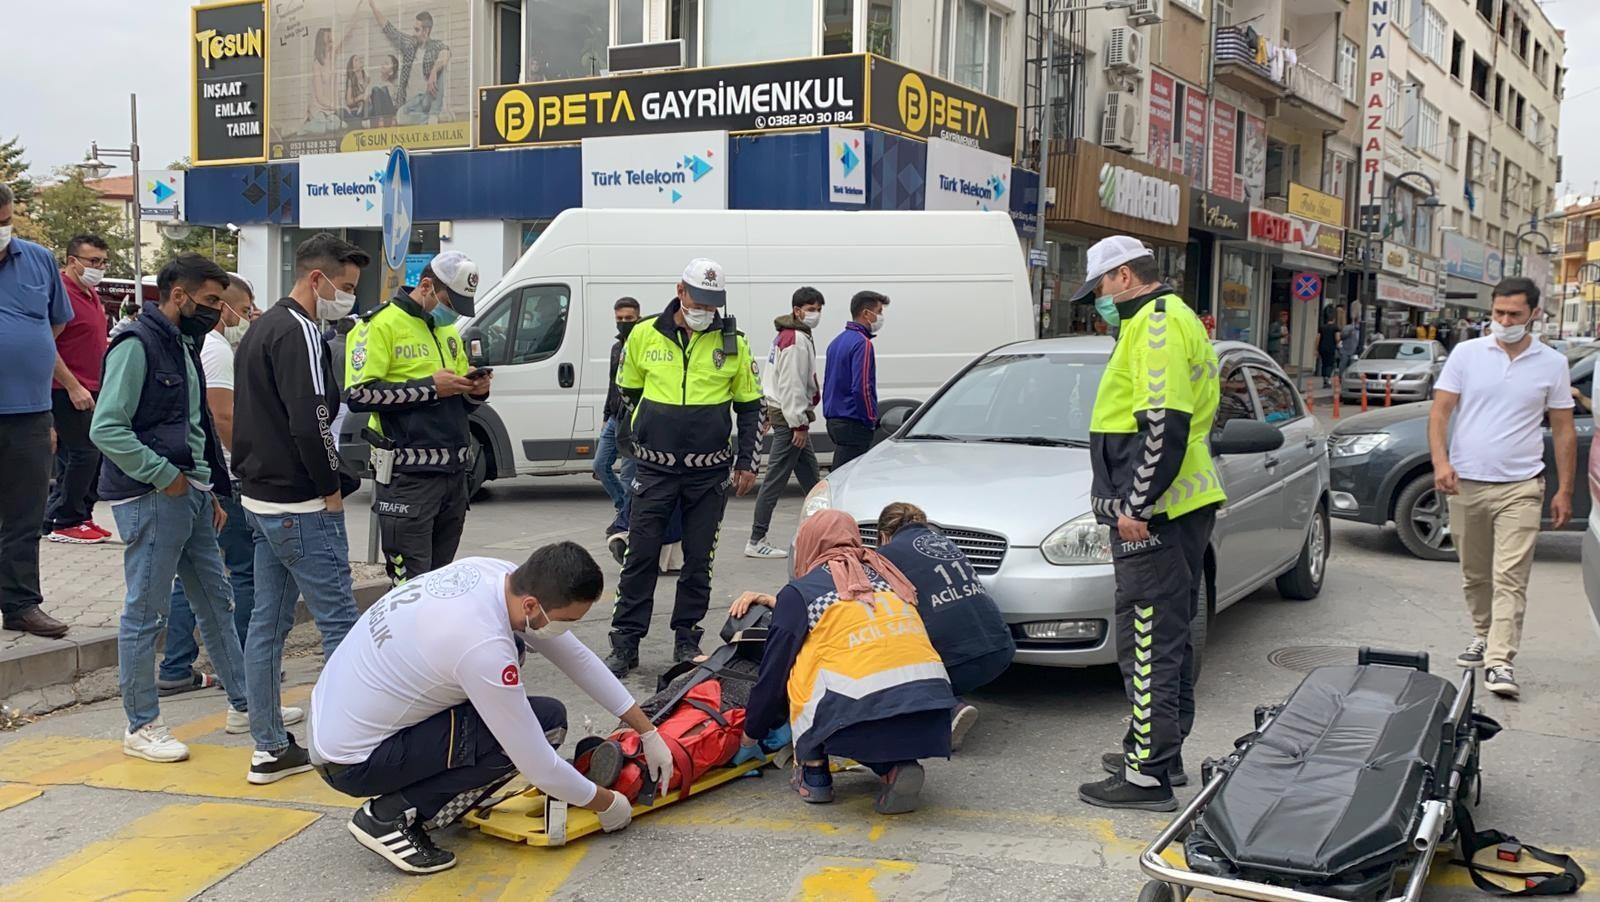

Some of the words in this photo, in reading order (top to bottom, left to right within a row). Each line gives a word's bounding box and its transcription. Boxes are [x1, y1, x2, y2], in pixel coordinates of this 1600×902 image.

[215, 101, 252, 117] EMLAK
[539, 90, 636, 139] BETA
[642, 77, 853, 121] GAYRİMENKUL
[930, 90, 990, 139] BETA
[768, 115, 797, 126] 0382
[799, 113, 814, 124] 20
[817, 112, 832, 123] 30
[834, 111, 854, 122] 184
[227, 121, 260, 136] TARIM
[432, 130, 464, 142] EMLAK
[592, 171, 621, 186] Türk
[626, 168, 685, 185] Telekom
[306, 183, 329, 197] Türk
[332, 182, 376, 196] Telekom
[939, 174, 958, 193] Türk
[959, 177, 992, 200] Telekom
[316, 404, 338, 470] adidas
[931, 586, 963, 608] ACİL
